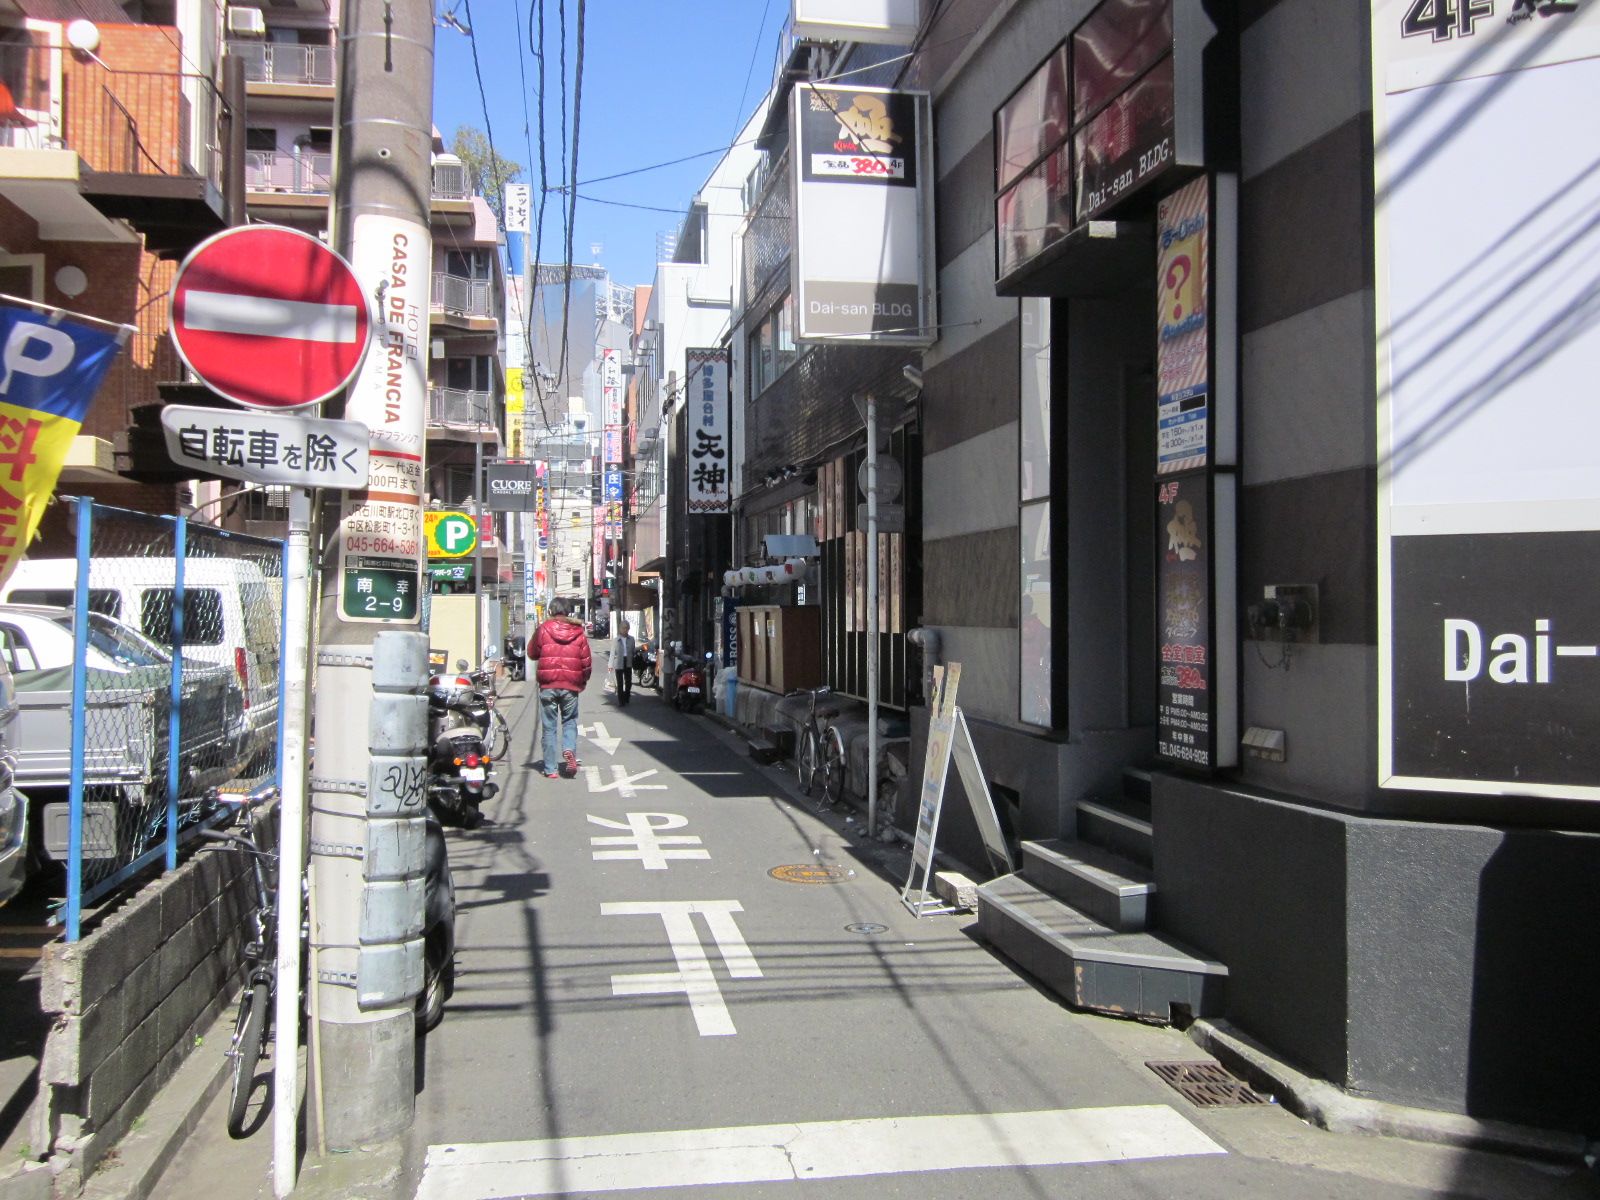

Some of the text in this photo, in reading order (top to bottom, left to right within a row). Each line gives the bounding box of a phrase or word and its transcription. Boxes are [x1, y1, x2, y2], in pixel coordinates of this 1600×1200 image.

[1088, 168, 1133, 213] Dai-san
[810, 301, 912, 317] Dai-san BLDG
[384, 233, 408, 424] CASA DE FRANCIA
[405, 304, 419, 364] HOTEL
[0, 321, 76, 394] P
[179, 424, 358, 474] 自転車を除く
[692, 428, 726, 493] 天神
[491, 479, 532, 490] CUORE
[1158, 481, 1179, 504] 4F
[446, 520, 469, 550] P
[357, 577, 409, 595] 南 幸
[452, 566, 465, 579] 空
[365, 596, 403, 613] 2-9
[729, 626, 738, 660] BOSS
[1444, 618, 1597, 684] Dai-
